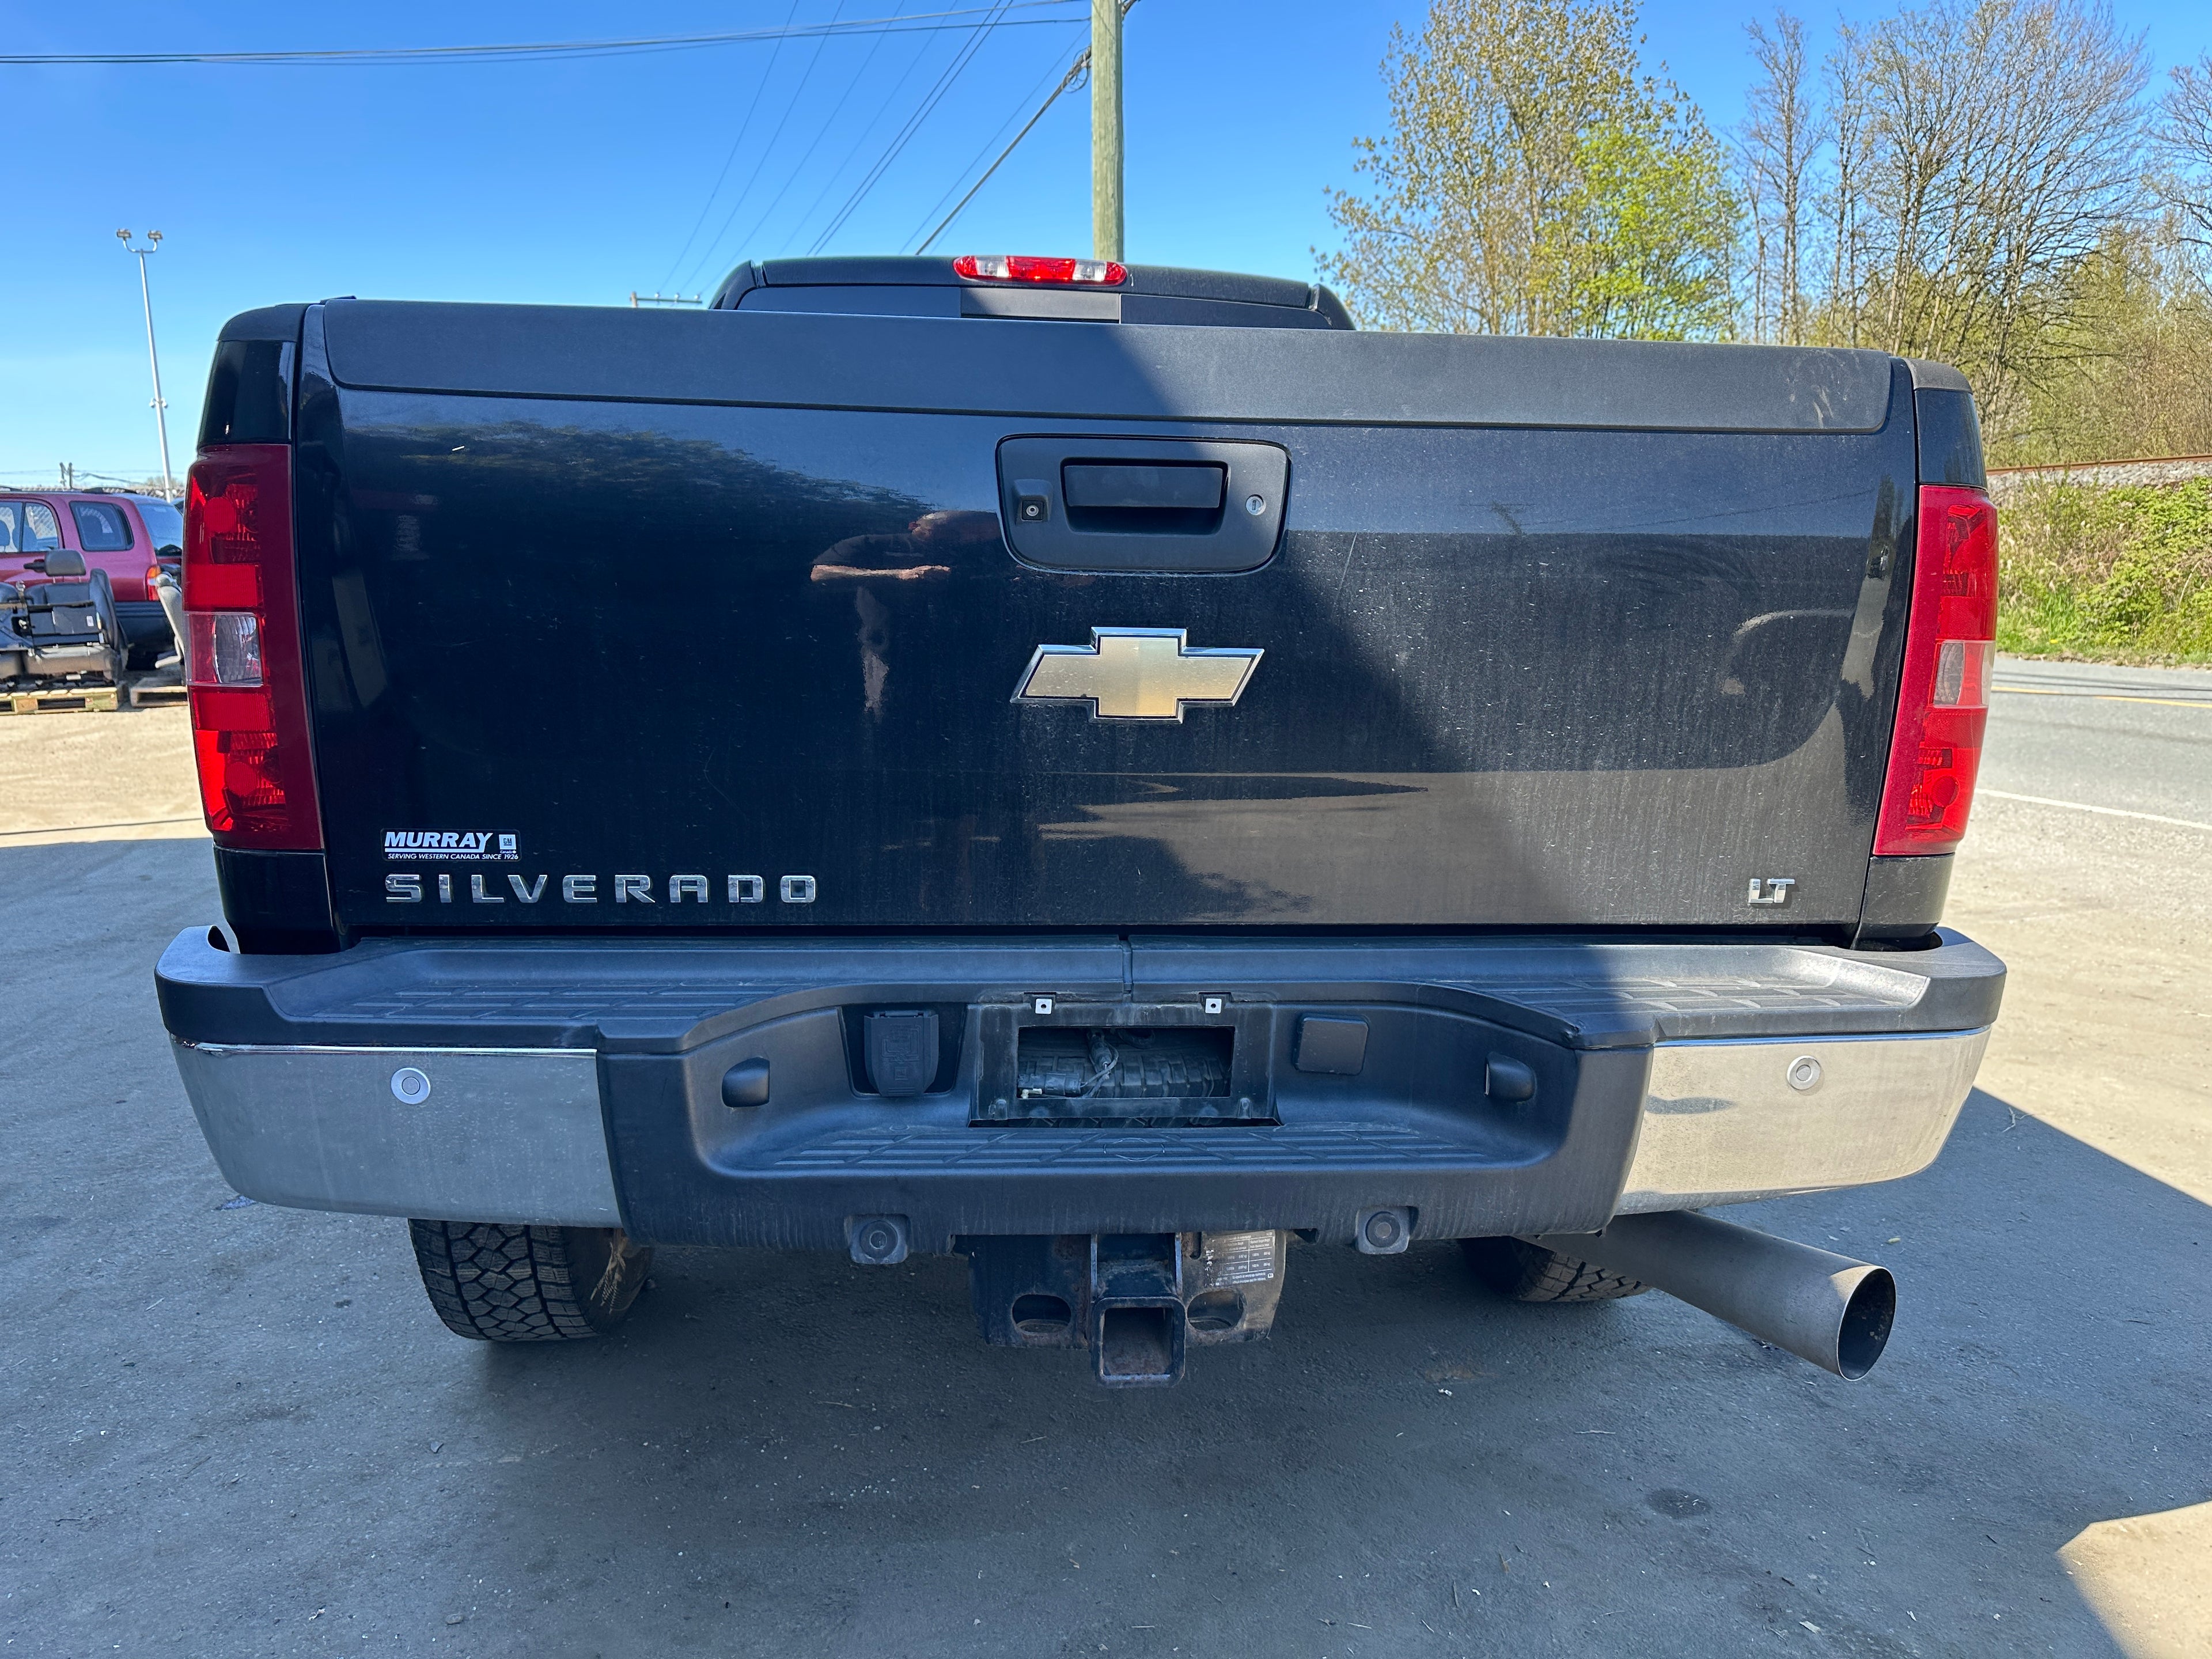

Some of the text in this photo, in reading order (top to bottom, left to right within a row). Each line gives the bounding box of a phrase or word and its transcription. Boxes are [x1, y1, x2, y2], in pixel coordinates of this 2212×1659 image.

[384, 831, 493, 852] MURRAY
[385, 873, 816, 903] SILVERADO
[1748, 878, 1796, 903] LT
